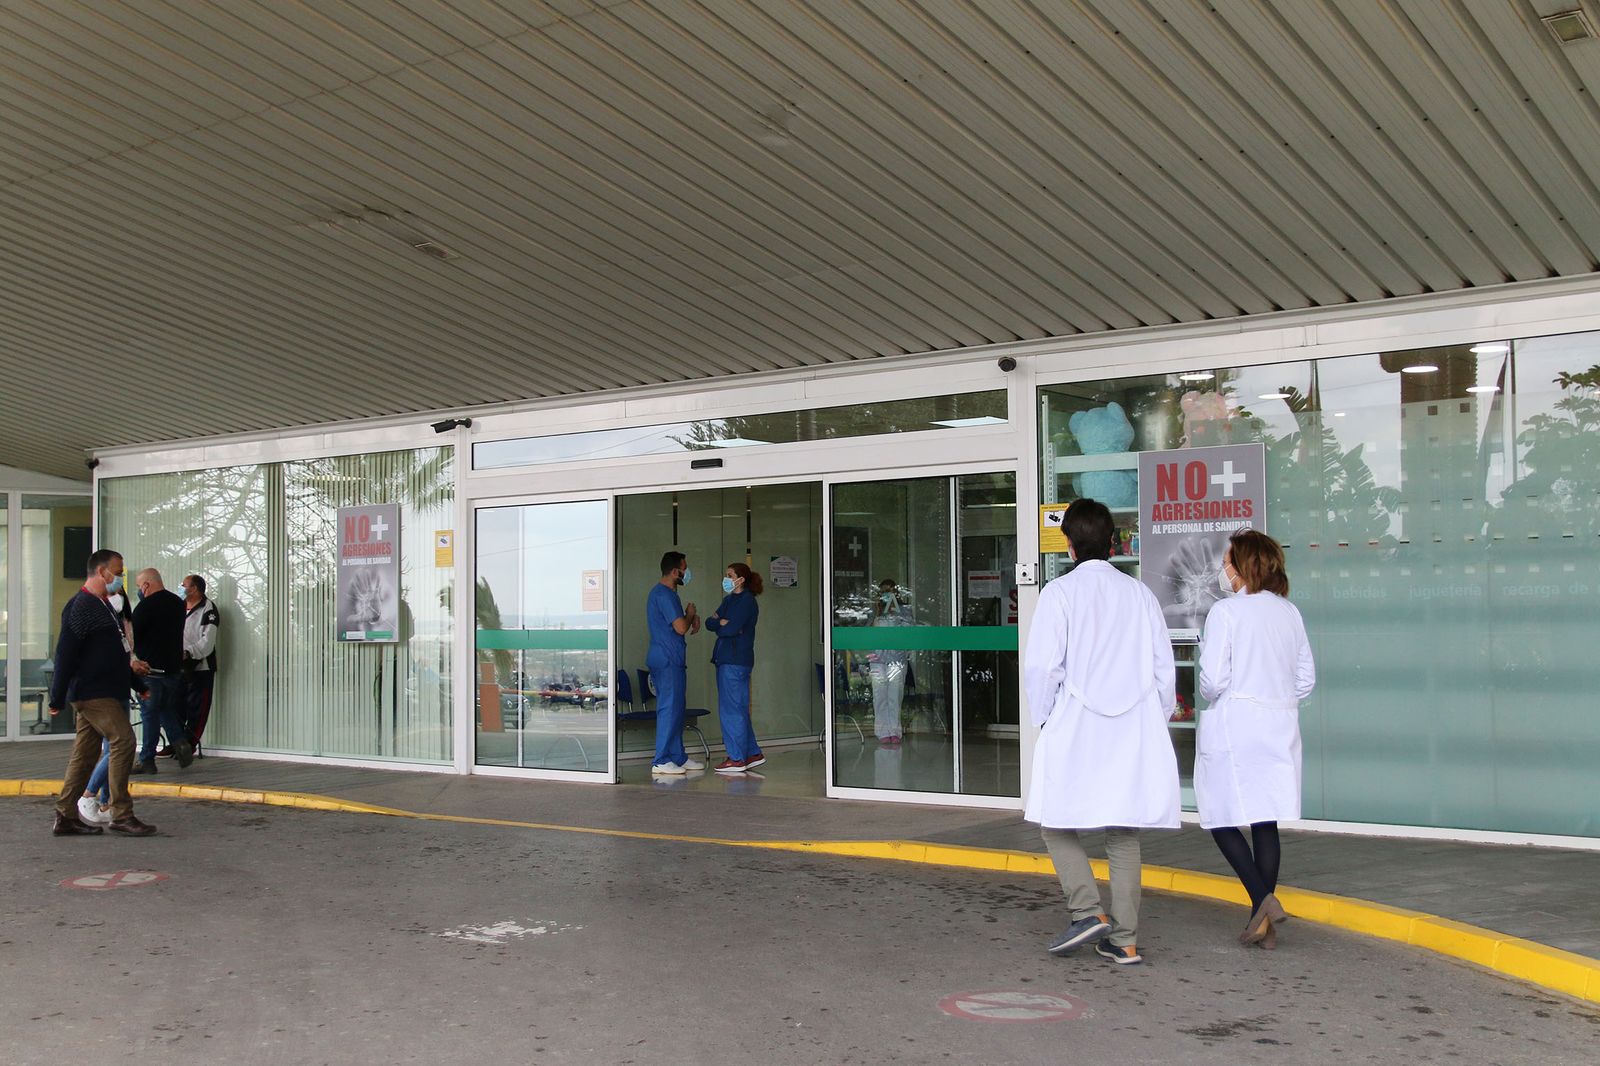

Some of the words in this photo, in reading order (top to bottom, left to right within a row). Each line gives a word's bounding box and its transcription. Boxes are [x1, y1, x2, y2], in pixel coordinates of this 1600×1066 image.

[1156, 460, 1208, 502] NO
[1151, 498, 1254, 522] AGRESIONES
[344, 514, 370, 544] NO
[1152, 524, 1162, 535] AL
[1162, 522, 1203, 534] PERSONAL
[1203, 521, 1215, 533] DE
[1215, 520, 1253, 532] SANIDAD
[342, 541, 392, 558] AGRESIONES
[1502, 584, 1561, 599] recarga
